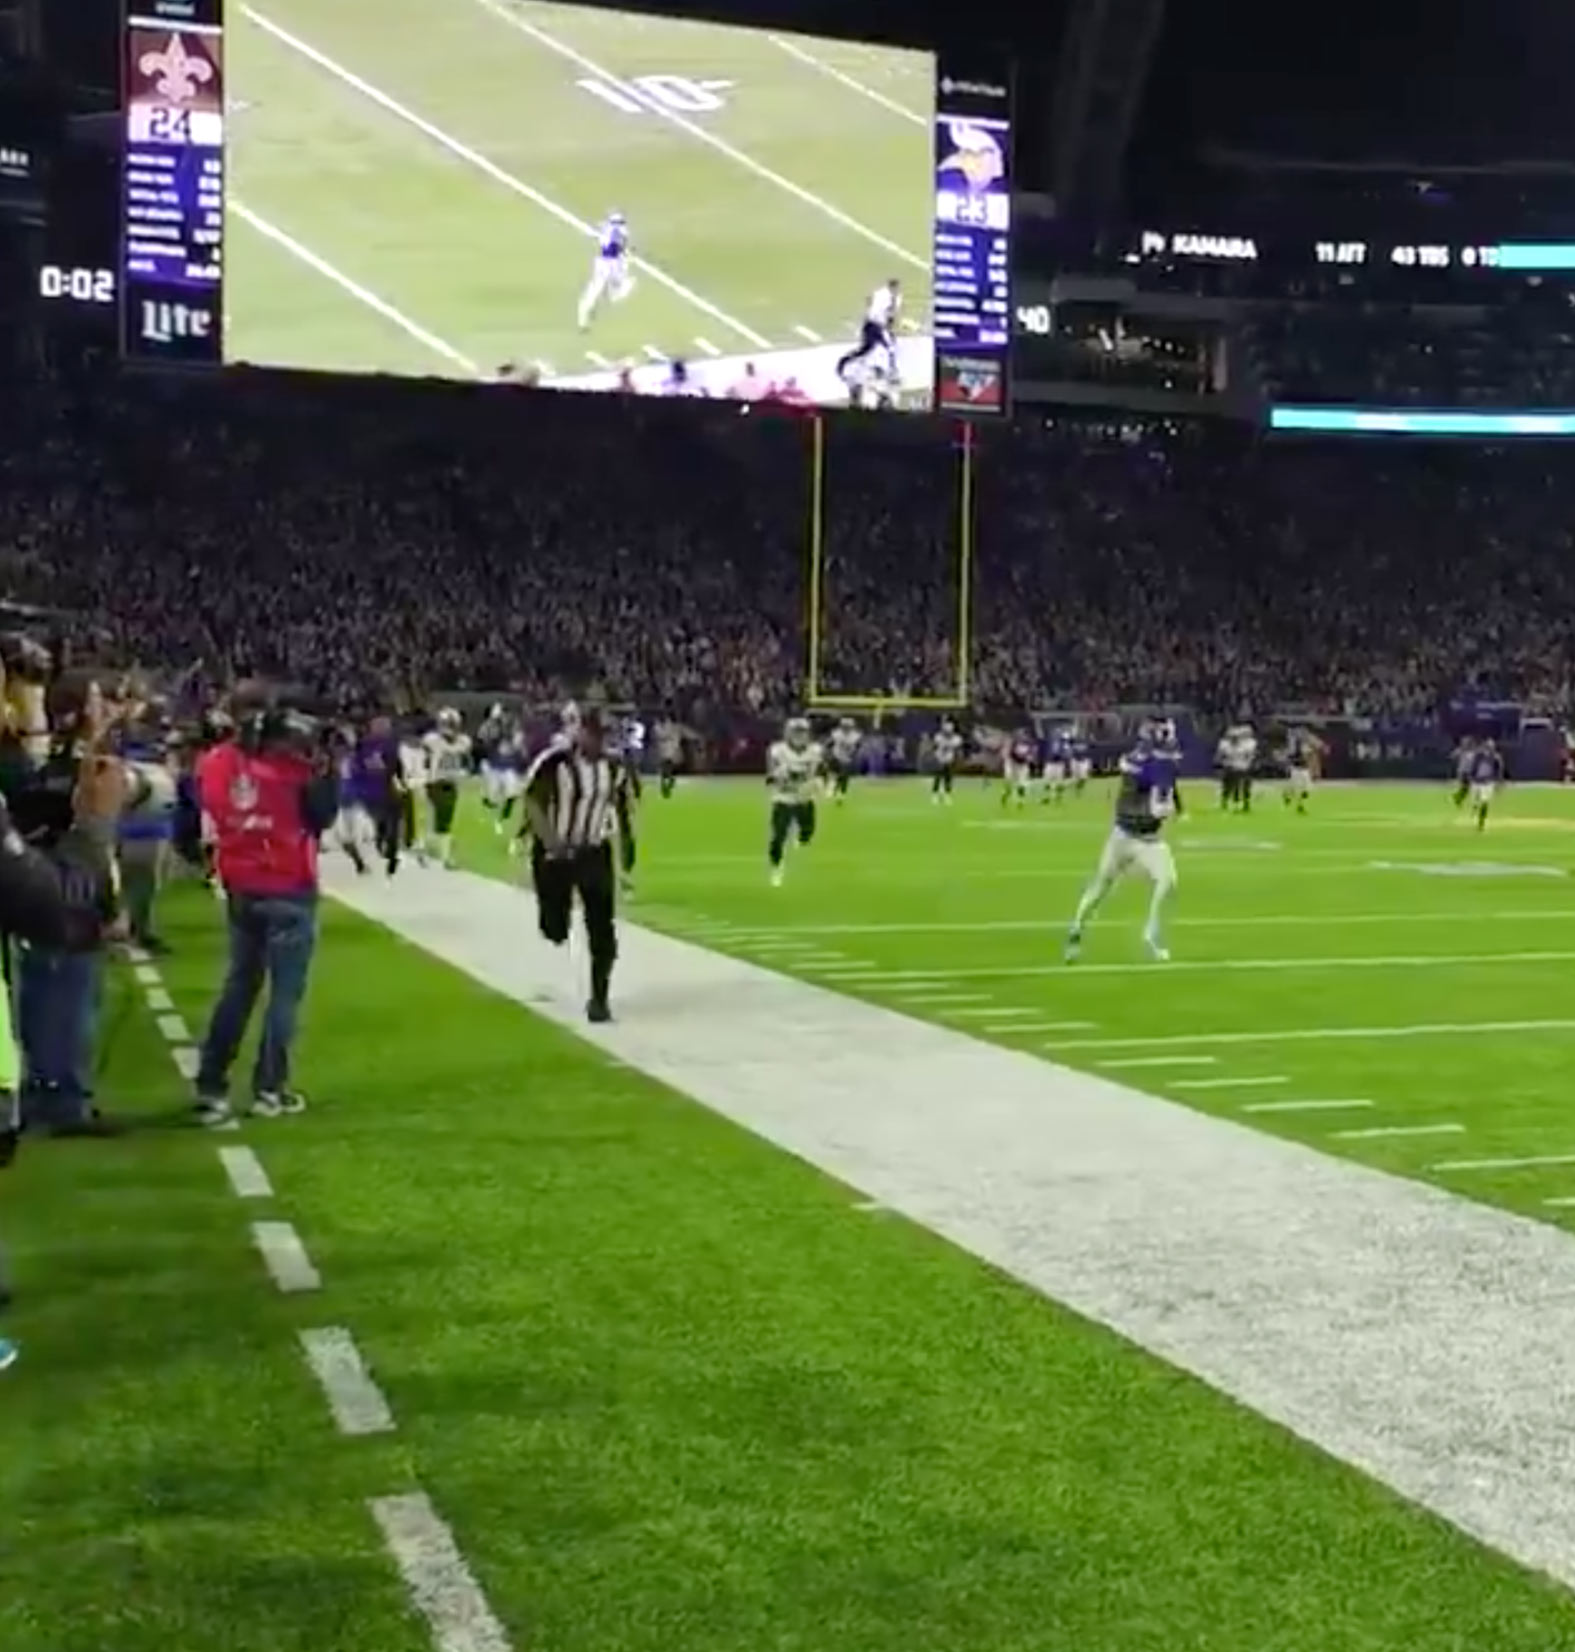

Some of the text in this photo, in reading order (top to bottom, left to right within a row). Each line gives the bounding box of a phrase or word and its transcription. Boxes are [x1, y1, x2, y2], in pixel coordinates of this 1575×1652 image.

[150, 107, 191, 139] 24
[1172, 233, 1257, 259] KAMARA
[1316, 242, 1335, 263] 11
[1336, 242, 1366, 263] ATT
[41, 266, 114, 302] 0:02
[142, 301, 211, 342] Lite
[1017, 306, 1050, 334] 40
